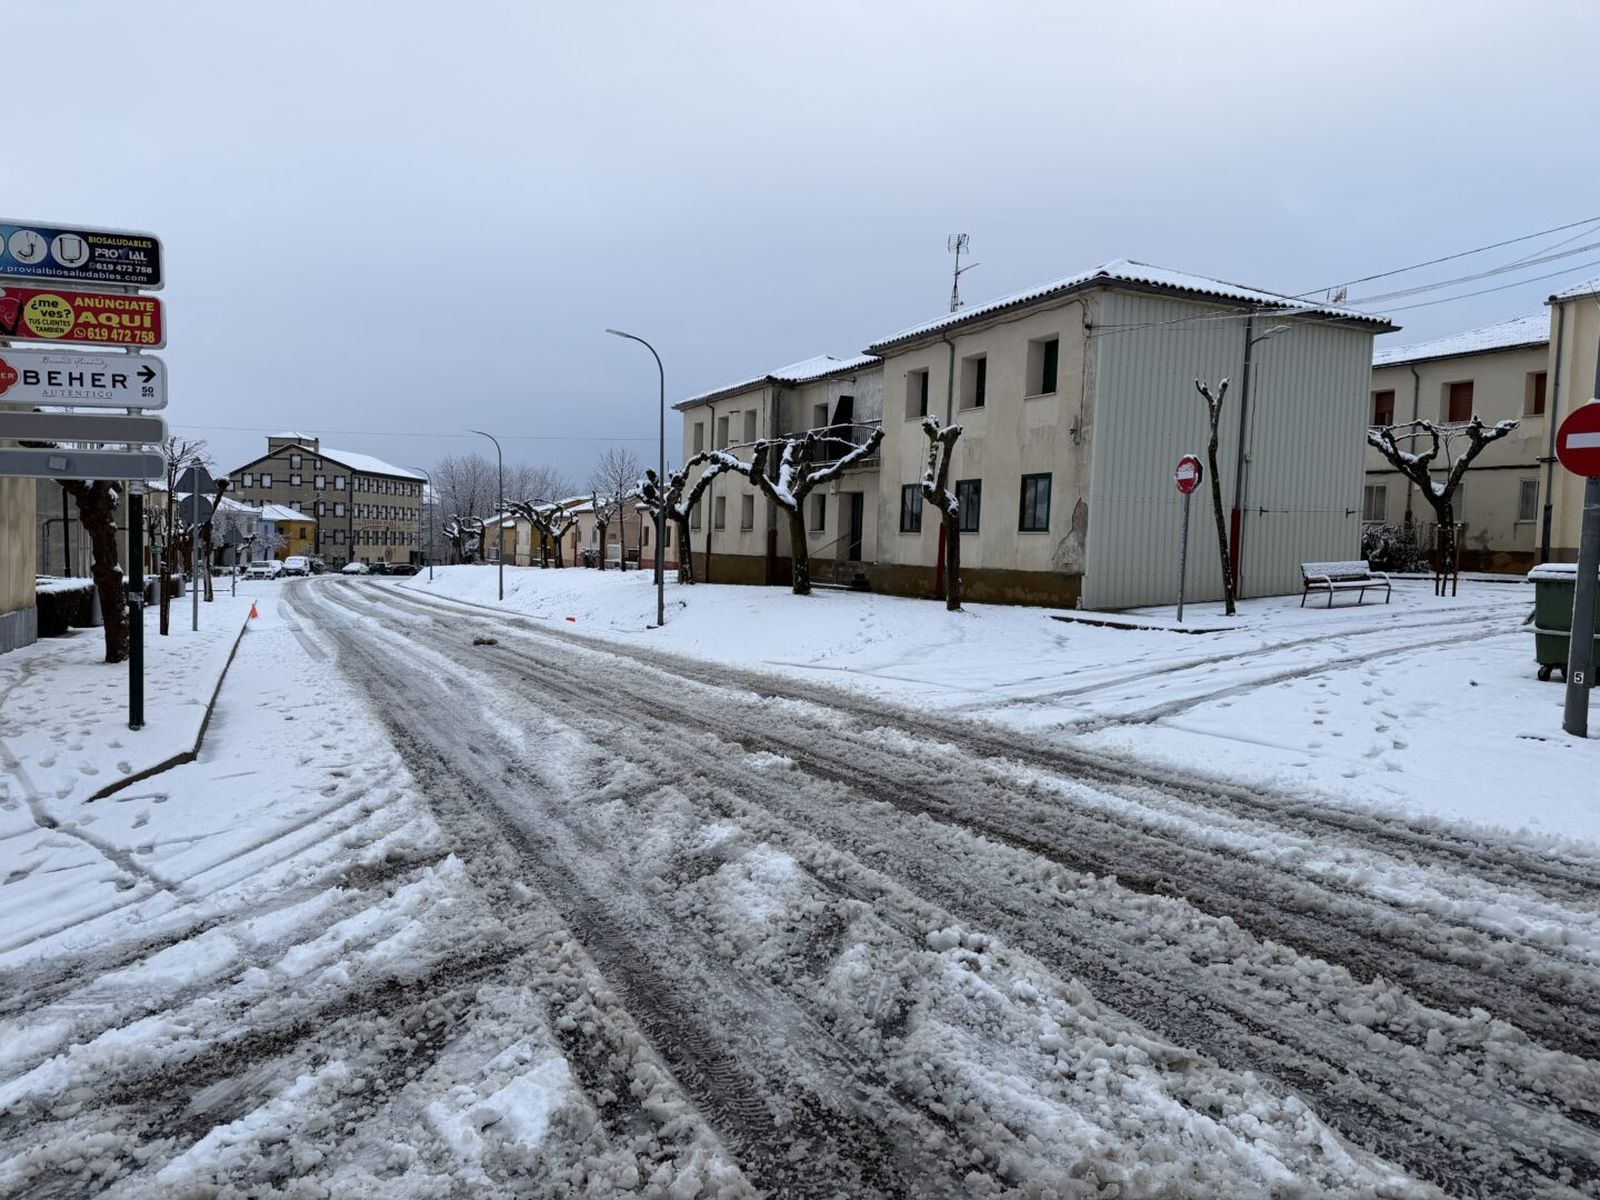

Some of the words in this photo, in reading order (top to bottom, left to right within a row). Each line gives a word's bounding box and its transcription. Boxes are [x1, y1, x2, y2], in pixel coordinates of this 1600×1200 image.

[88, 236, 152, 248] BIOSALUDABLES
[0, 265, 147, 282] .provialbiosaludables.com
[96, 262, 114, 271] 619
[116, 264, 133, 273] 472
[135, 265, 153, 274] 758
[31, 299, 59, 310] ¿me
[74, 296, 155, 312] ANÚNCIATE
[41, 308, 71, 319] ves?
[77, 311, 152, 328] AQUÍ
[28, 318, 41, 326] TUS
[42, 319, 71, 327] CLIENTES
[87, 327, 108, 340] 619
[111, 328, 131, 342] 472
[134, 330, 155, 343] 758
[23, 370, 128, 389] BEHER
[1575, 672, 1583, 683] 5
